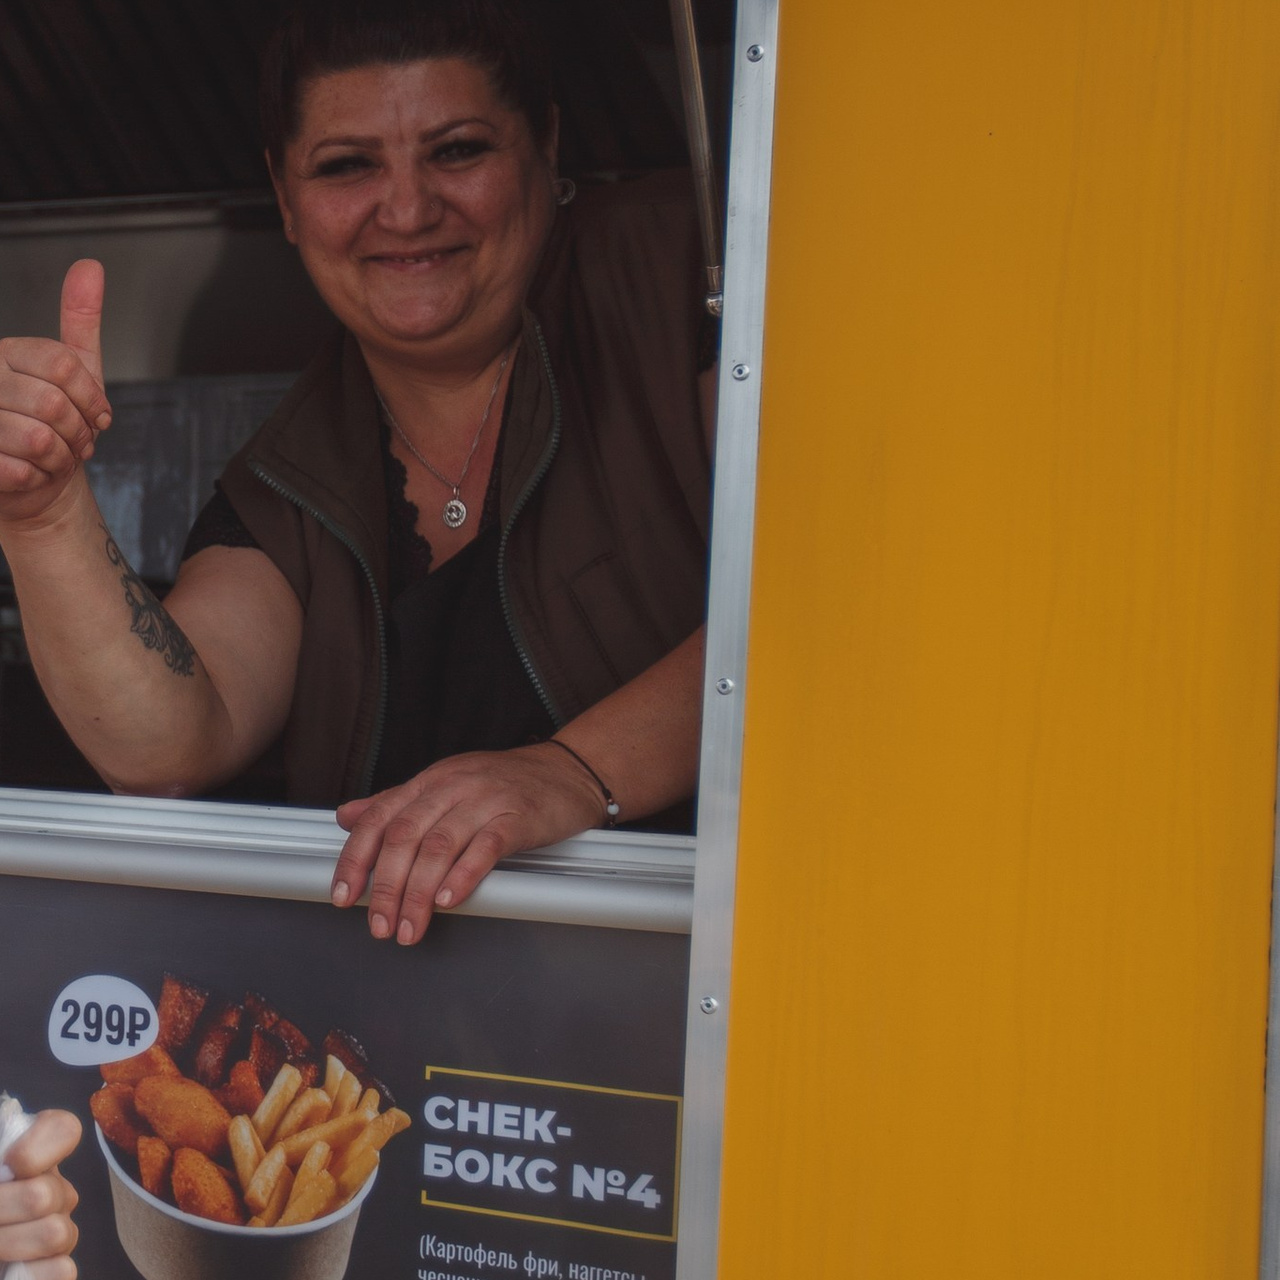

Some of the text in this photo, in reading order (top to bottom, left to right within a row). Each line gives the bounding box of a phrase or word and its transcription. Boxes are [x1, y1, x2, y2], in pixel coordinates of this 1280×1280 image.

[423, 1095, 572, 1144] СНЕК-
[423, 1143, 661, 1209] БОКС №4
[419, 1234, 518, 1270] (Картофель
[523, 1250, 563, 1280] фри,
